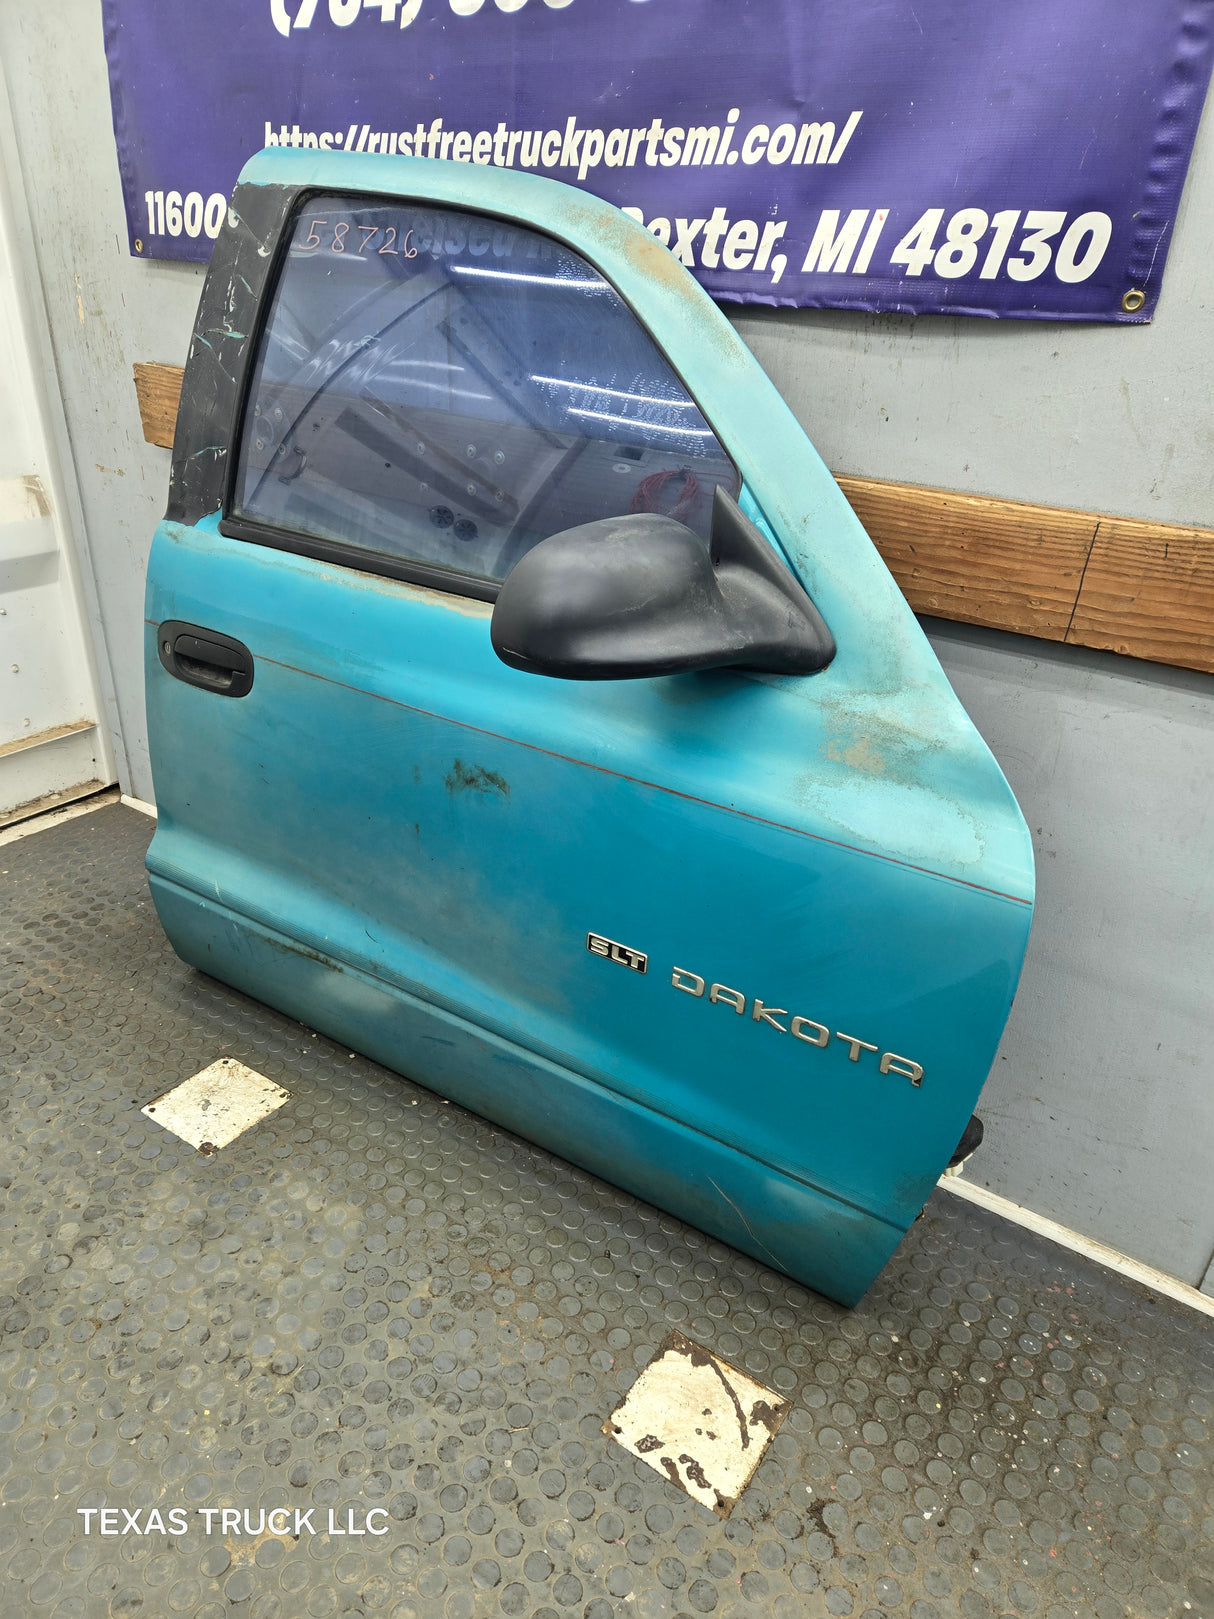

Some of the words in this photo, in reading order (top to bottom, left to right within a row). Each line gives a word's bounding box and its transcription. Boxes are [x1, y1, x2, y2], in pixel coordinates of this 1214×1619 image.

[145, 190, 228, 239] 11600
[801, 209, 890, 275] MI
[890, 208, 1113, 284] 48130
[299, 220, 418, 259] 58726
[589, 934, 646, 971] SLT
[671, 966, 924, 1088] DAKOTA
